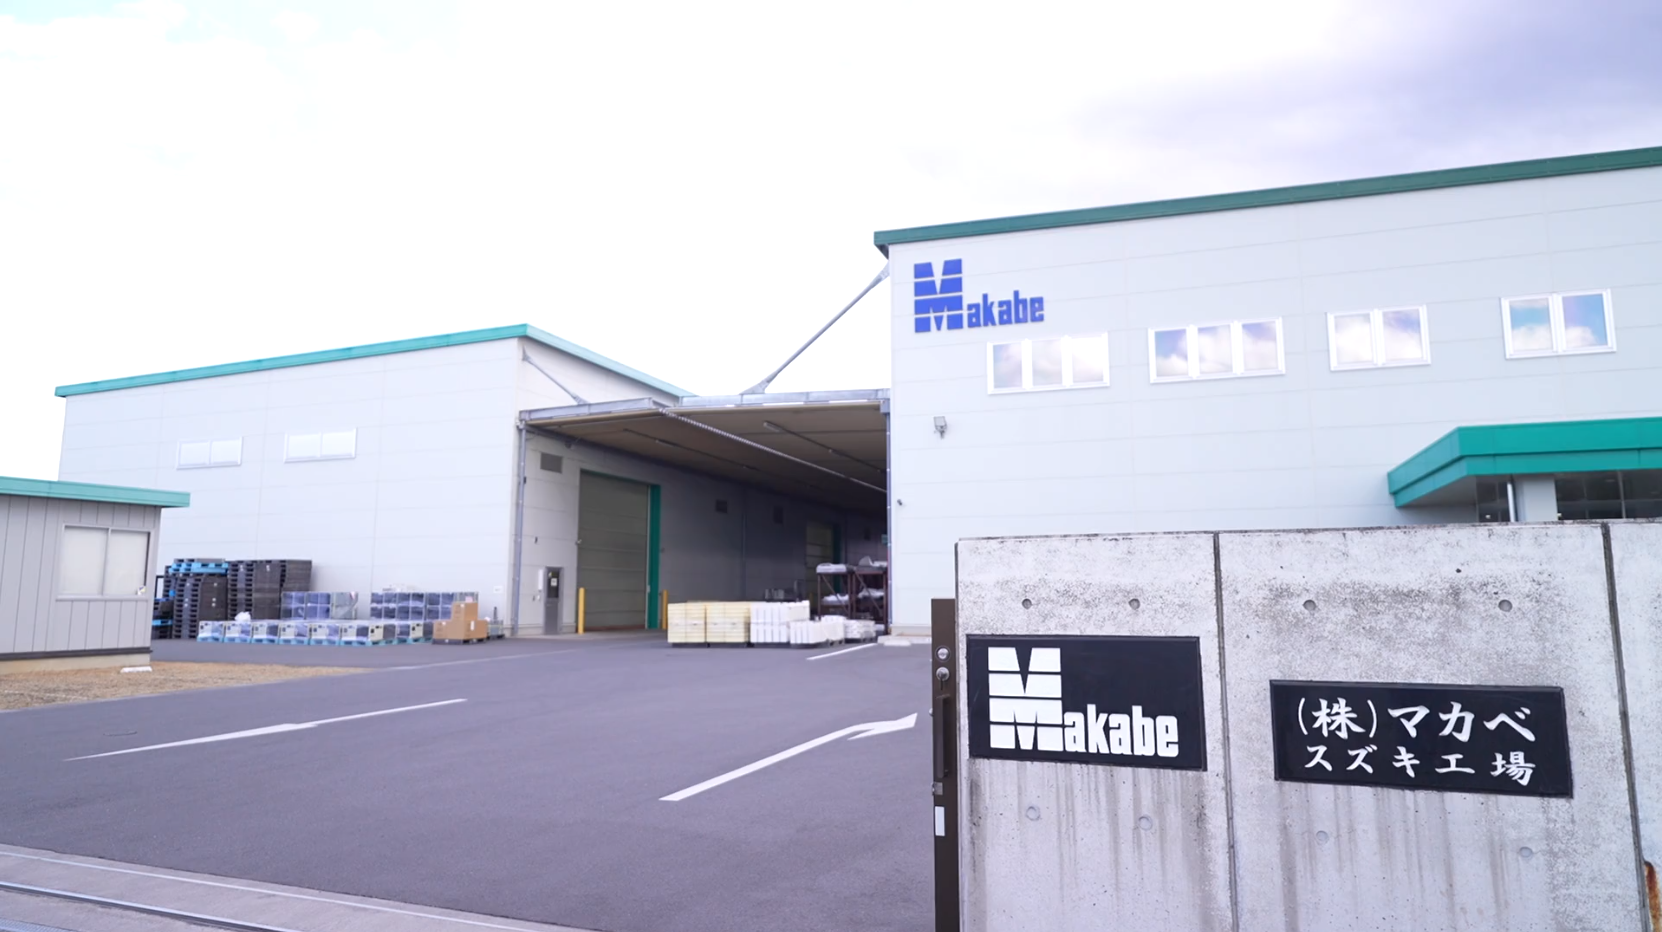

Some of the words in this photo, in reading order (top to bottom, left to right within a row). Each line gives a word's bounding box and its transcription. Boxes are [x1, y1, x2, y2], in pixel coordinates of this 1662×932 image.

[914, 258, 1044, 333] Makabe
[988, 646, 1179, 758] Makabe
[1297, 697, 1536, 743] (株)マカベ
[1304, 743, 1536, 787] スズキ工場
